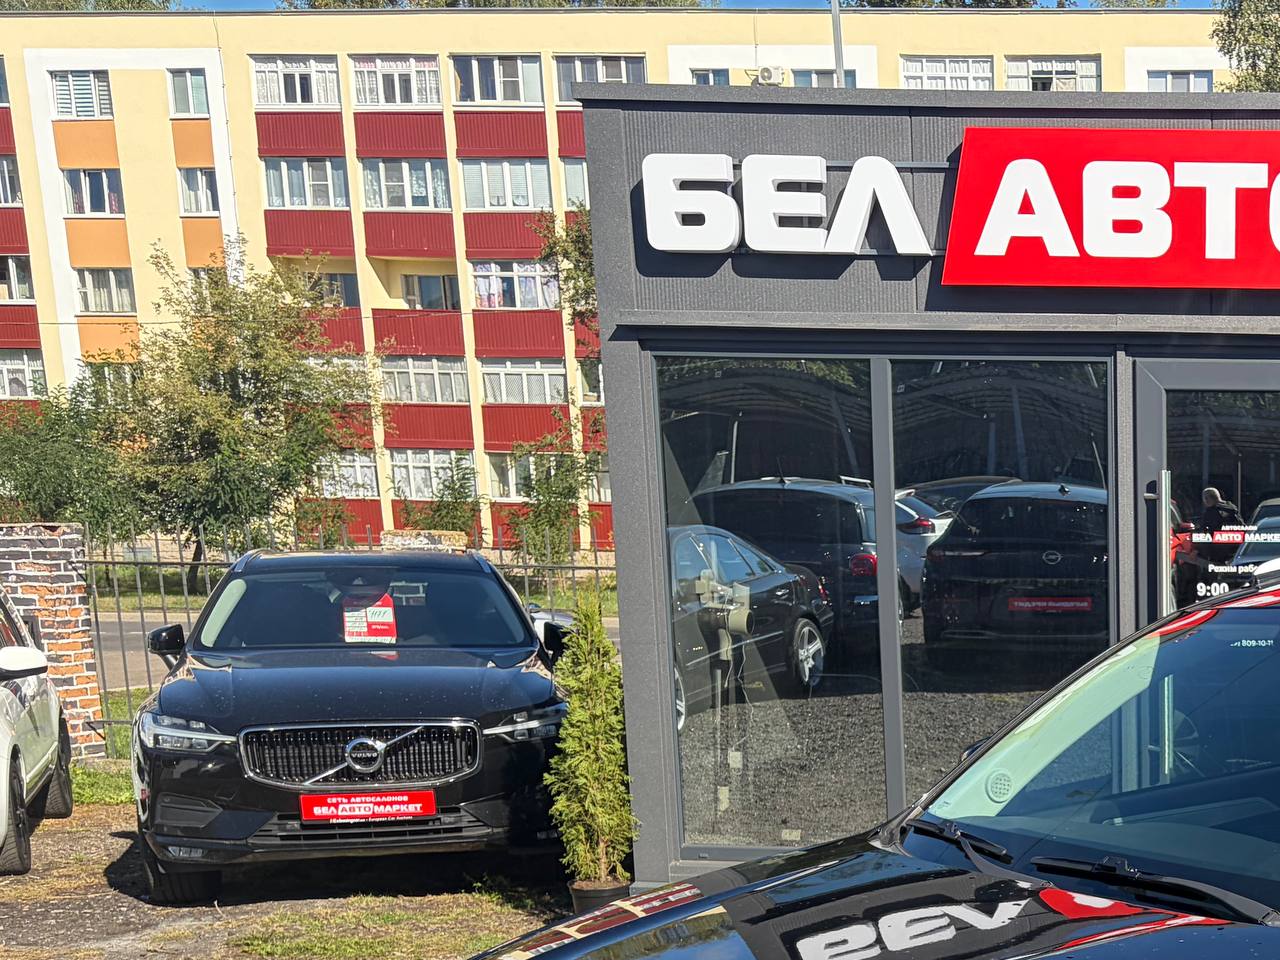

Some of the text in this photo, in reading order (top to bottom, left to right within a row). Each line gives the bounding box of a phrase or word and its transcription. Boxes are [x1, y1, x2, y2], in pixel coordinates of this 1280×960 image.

[642, 153, 933, 257] БЕЛ
[1192, 533, 1212, 543] БЕЛ
[1214, 533, 1242, 542] АВТО
[1208, 563, 1237, 573] Режим
[1196, 582, 1230, 597] 9:00
[350, 795, 409, 803] АВТОСАЛОНОВ
[313, 803, 423, 816] БЕЛ АВТО МАРКЕТ
